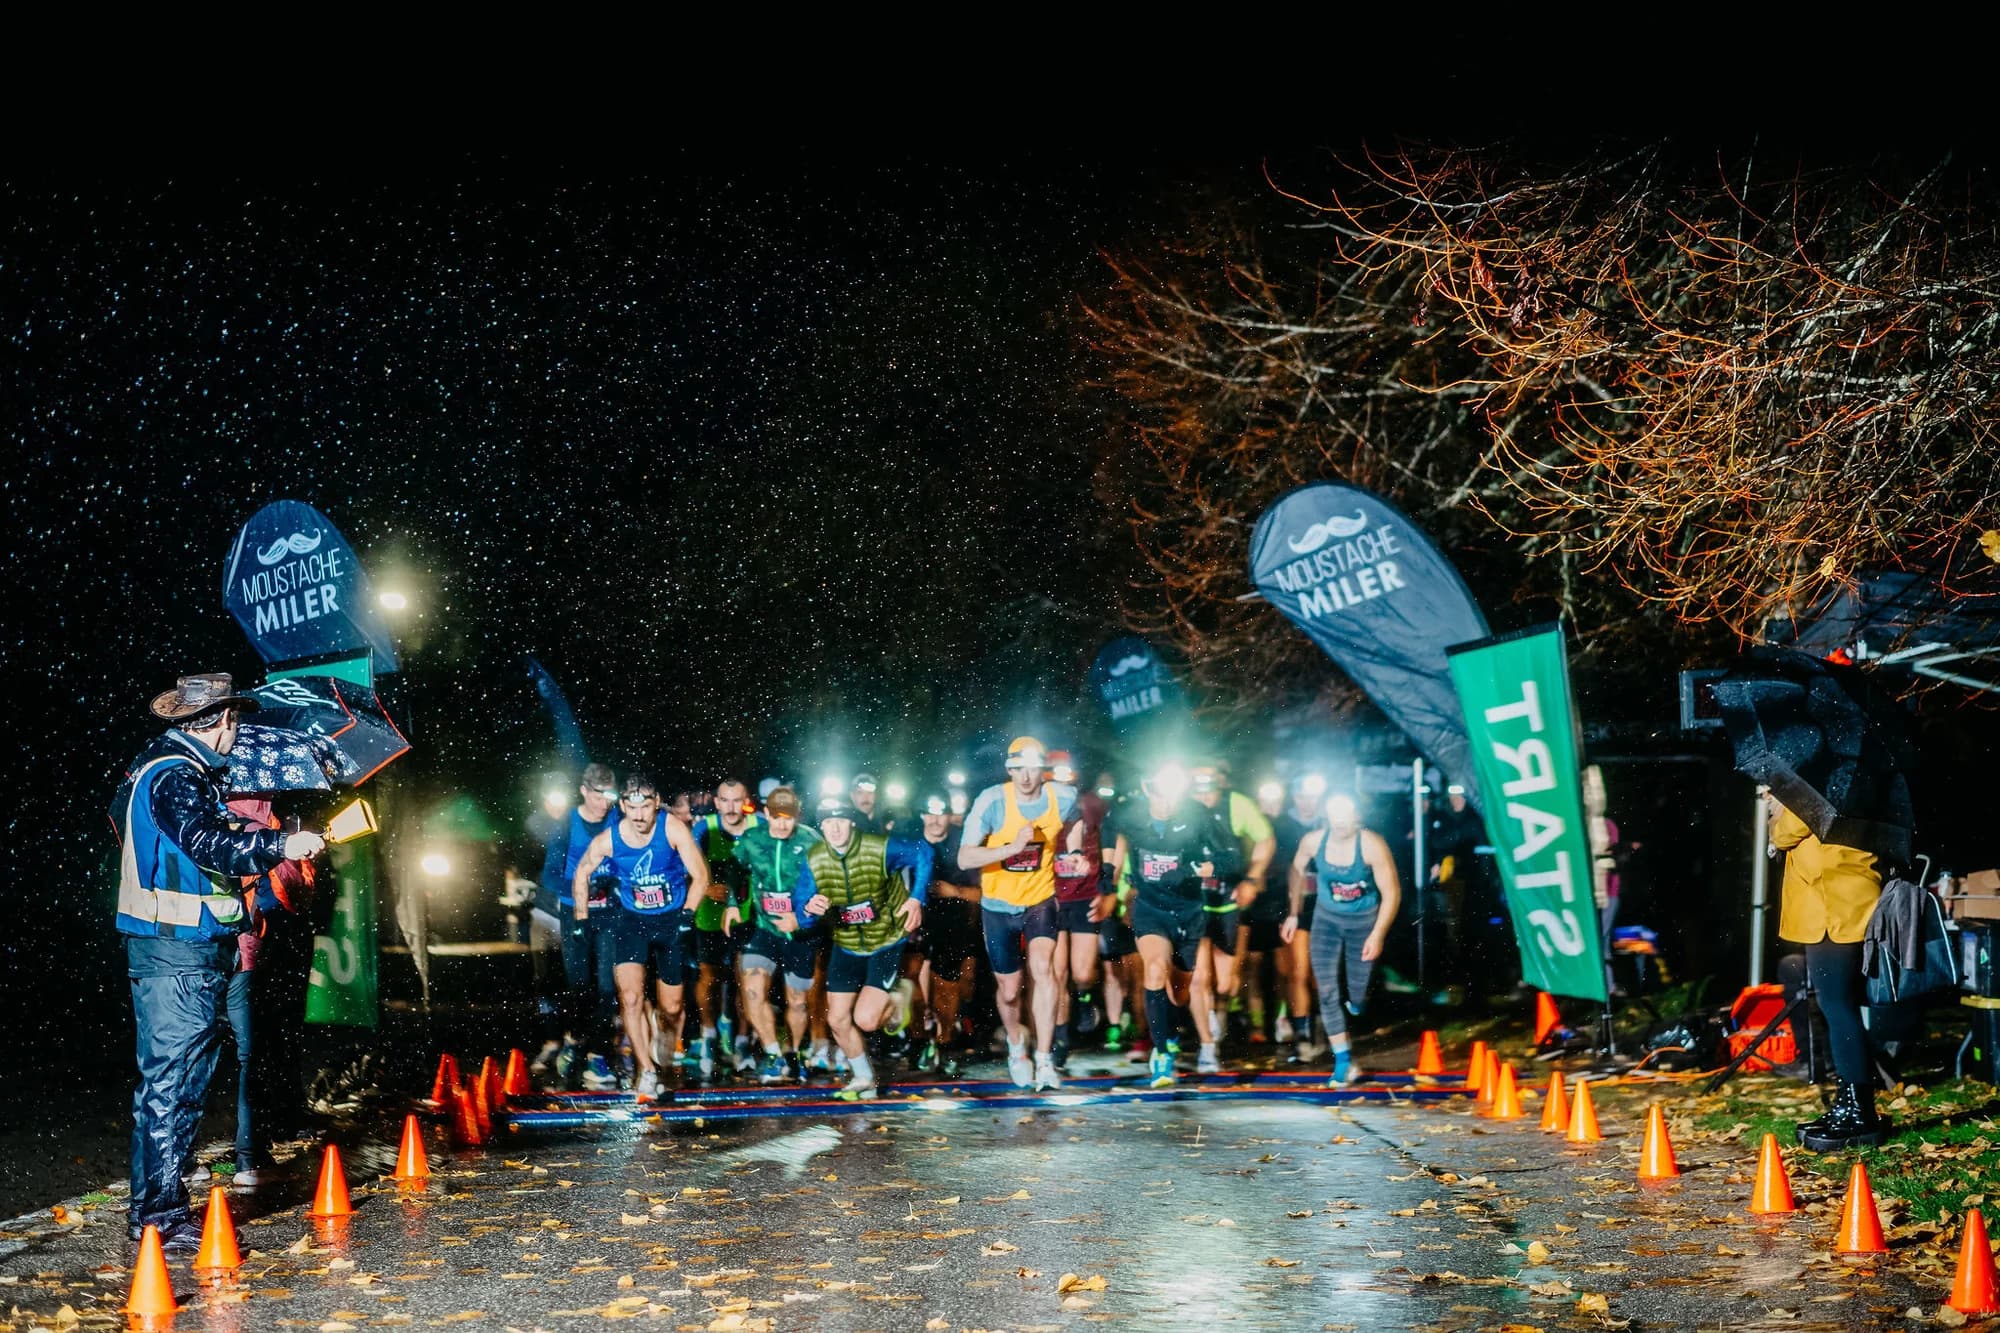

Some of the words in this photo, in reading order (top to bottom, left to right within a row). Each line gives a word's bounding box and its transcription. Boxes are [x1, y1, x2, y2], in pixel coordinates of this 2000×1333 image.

[242, 547, 344, 606] MOUSTACHE
[1274, 524, 1401, 593] MOUSTACHE
[255, 583, 340, 636] MILER
[1297, 561, 1406, 619] MILER
[1110, 687, 1164, 720] MILER
[641, 893, 658, 905] 201
[768, 900, 787, 911] 509
